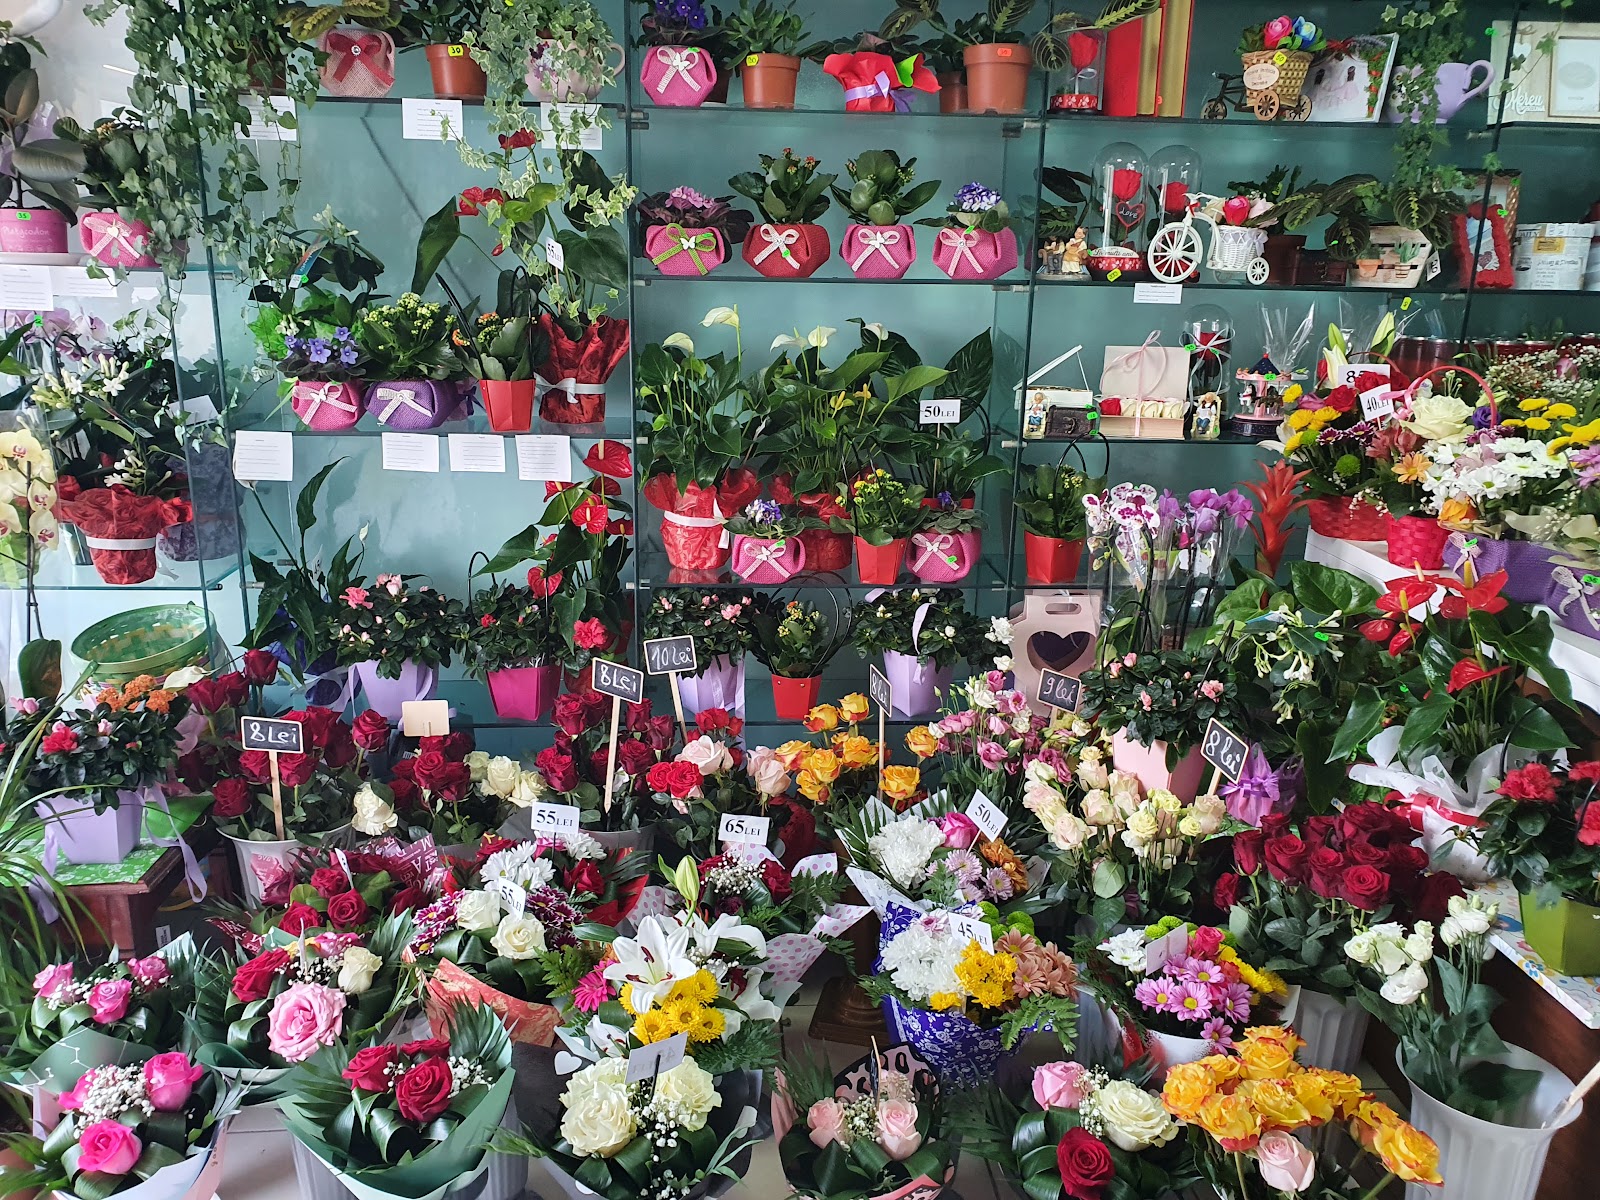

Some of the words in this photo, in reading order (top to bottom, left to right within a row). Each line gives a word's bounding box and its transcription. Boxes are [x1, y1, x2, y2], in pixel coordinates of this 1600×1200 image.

[1119, 207, 1138, 219] Love
[651, 645, 669, 671] 10
[600, 664, 611, 686] 8
[871, 672, 877, 695] 8
[1043, 677, 1056, 695] 9
[1055, 678, 1077, 703] lei
[250, 721, 266, 742] 8
[267, 726, 297, 744] Lei
[1205, 730, 1221, 757] 8
[1220, 736, 1241, 775] lei
